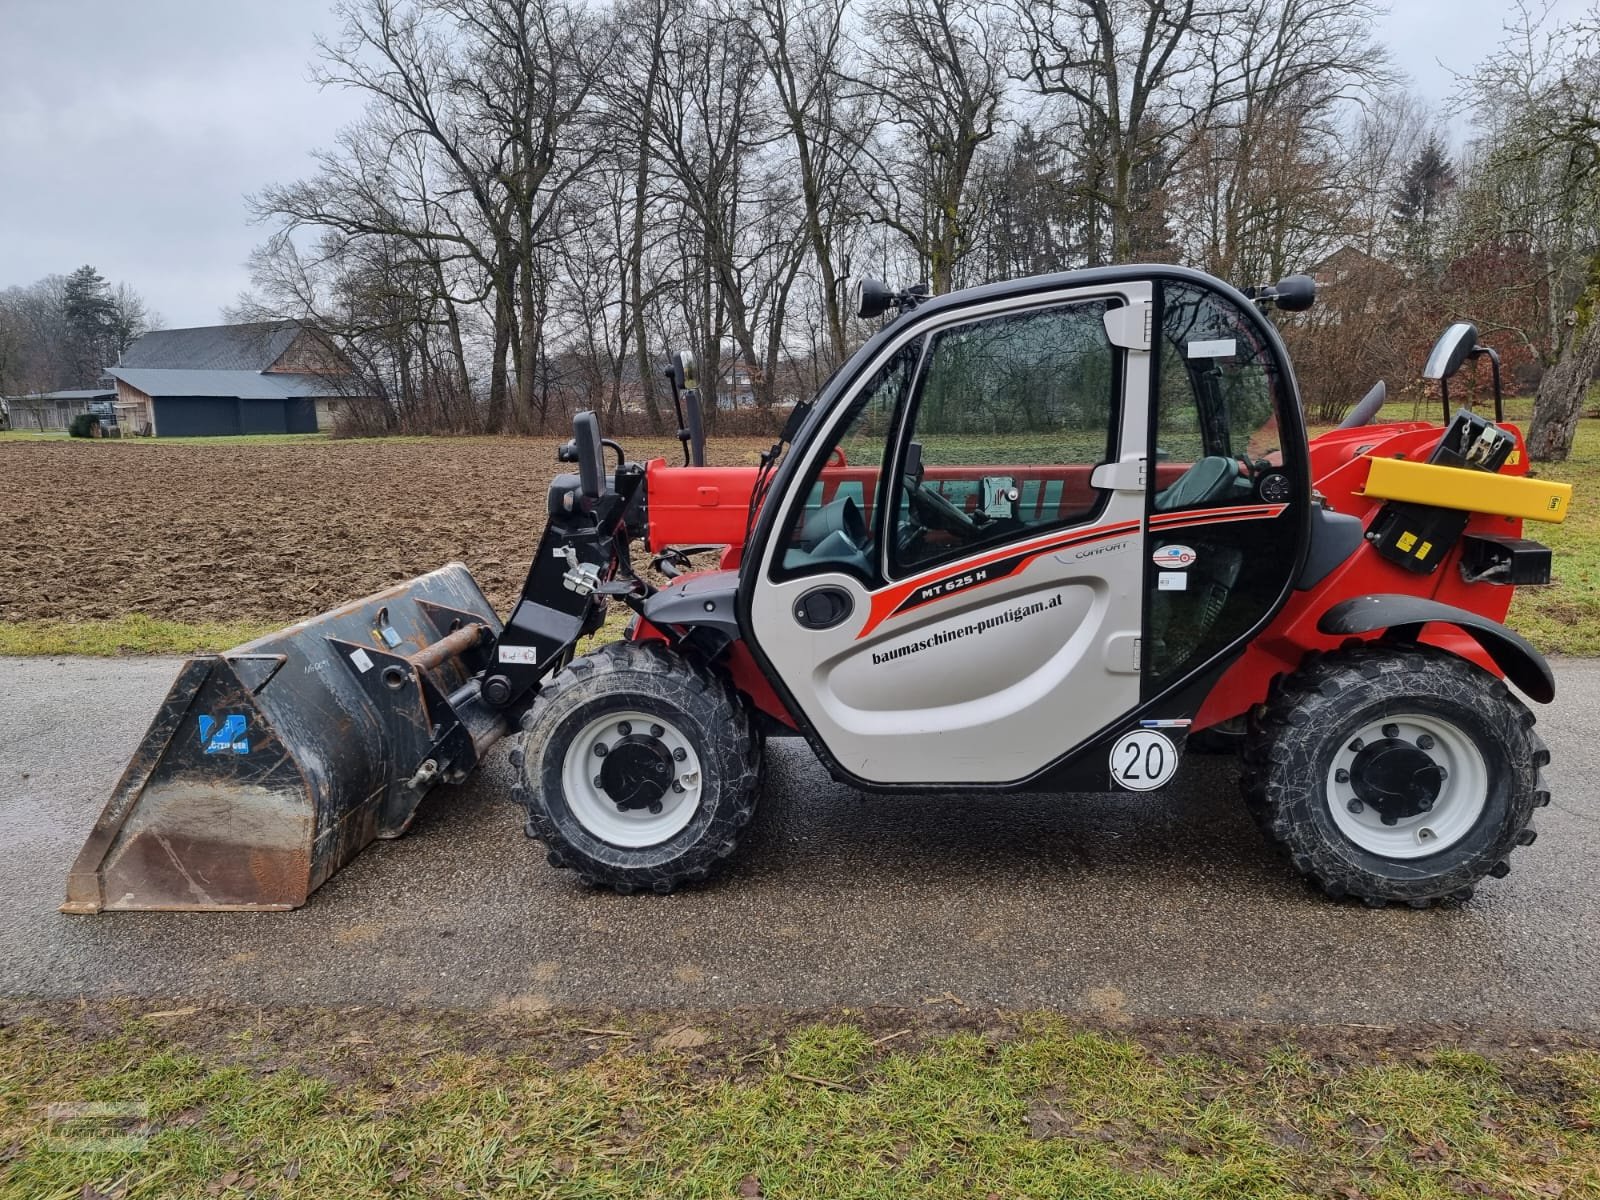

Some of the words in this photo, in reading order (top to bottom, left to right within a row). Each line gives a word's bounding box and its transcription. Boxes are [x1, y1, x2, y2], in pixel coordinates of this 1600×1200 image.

[921, 585, 942, 599] MT
[945, 575, 973, 591] 625
[976, 570, 987, 580] H
[872, 594, 1062, 665] baumaschinen-puntigam.at
[1122, 742, 1164, 780] 20
